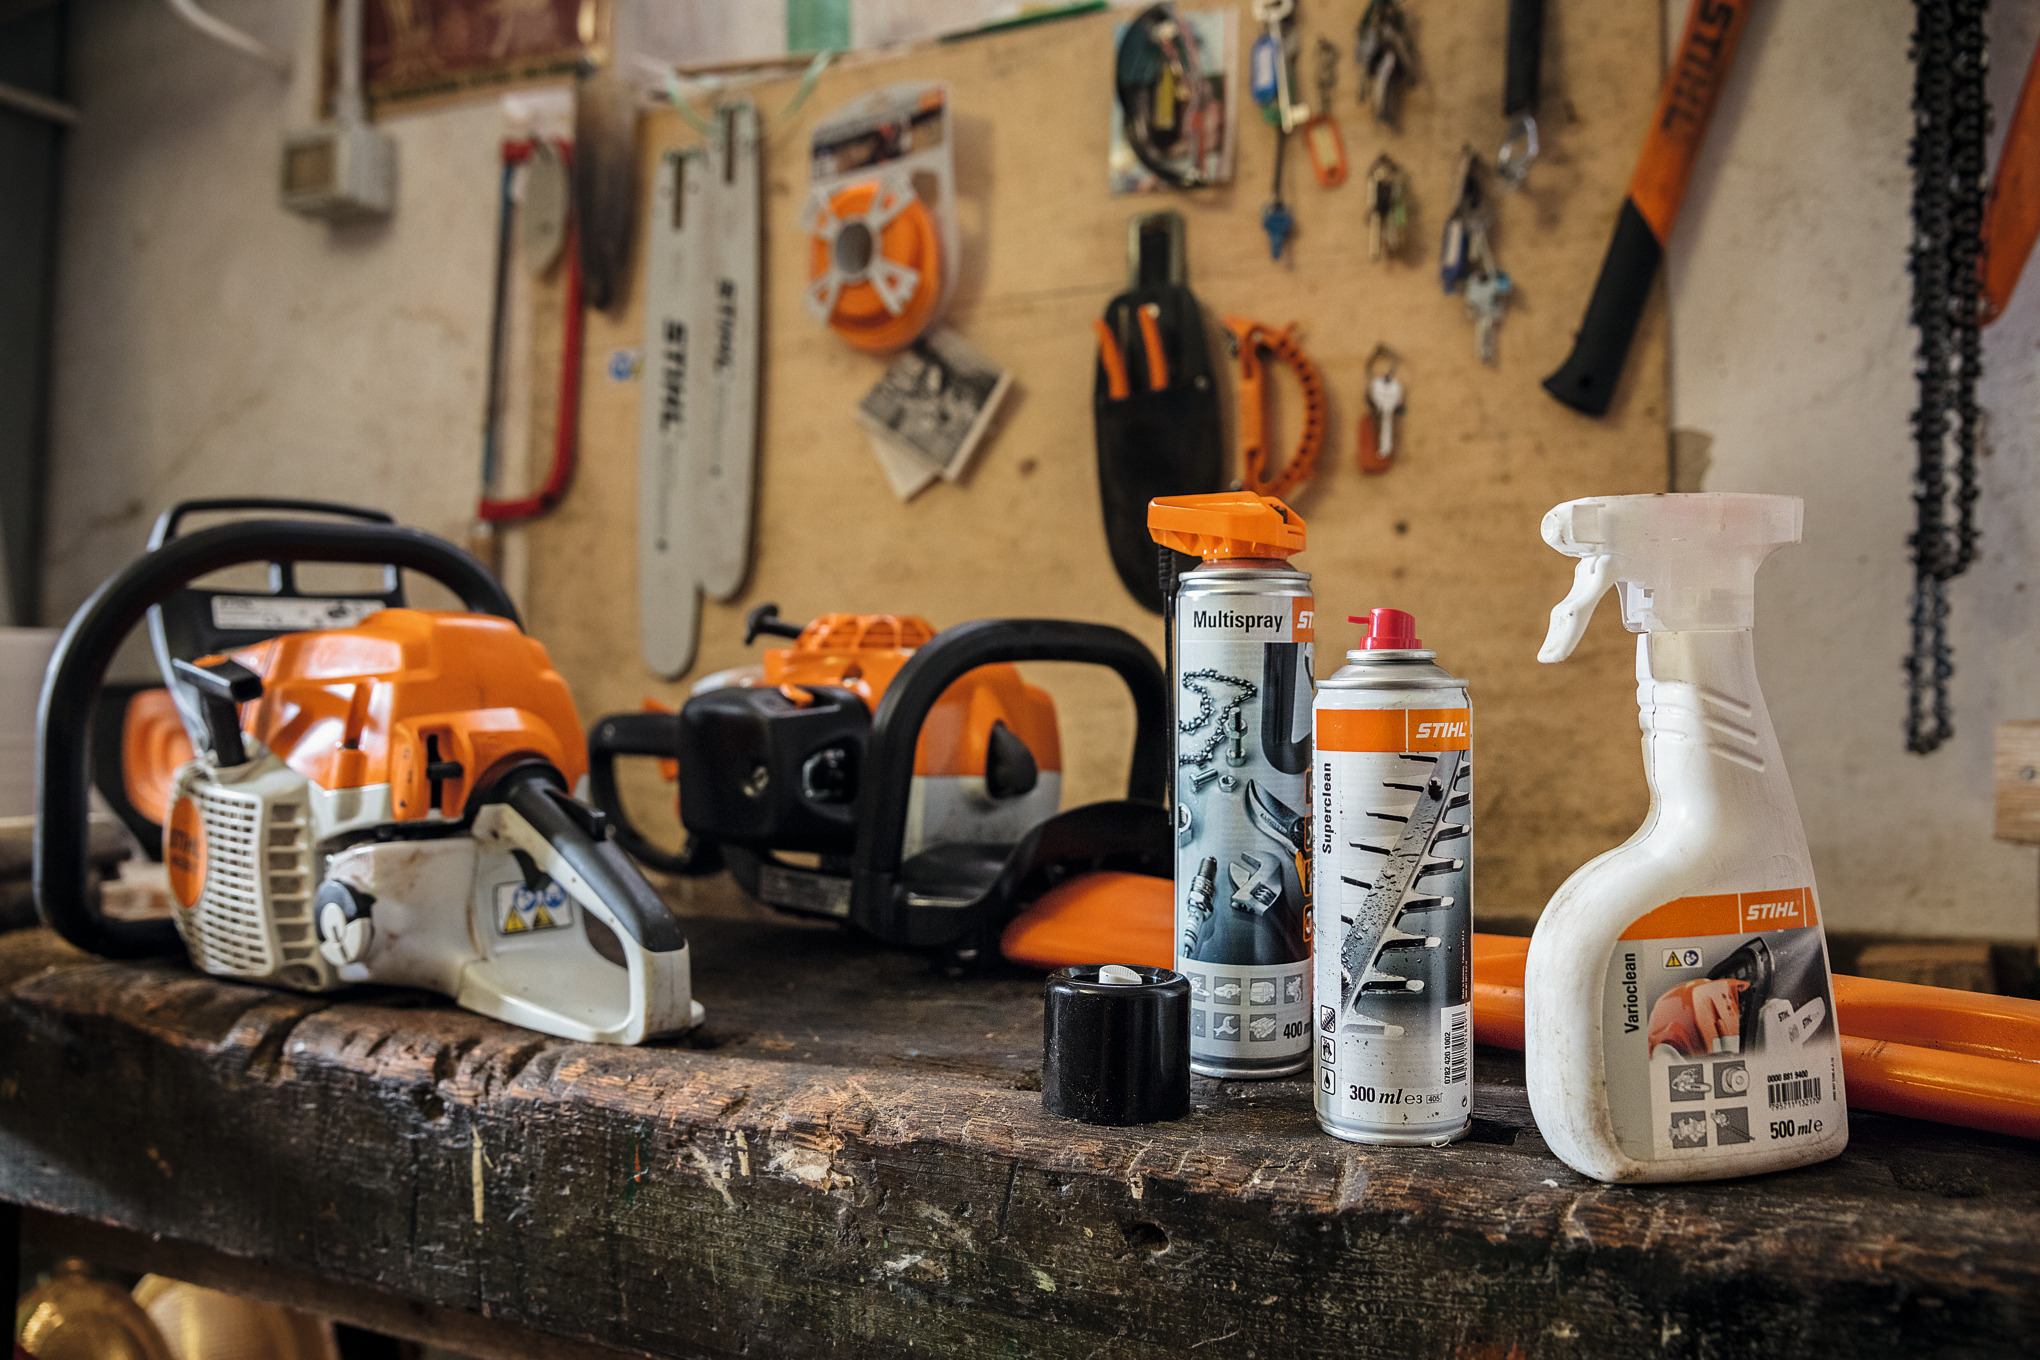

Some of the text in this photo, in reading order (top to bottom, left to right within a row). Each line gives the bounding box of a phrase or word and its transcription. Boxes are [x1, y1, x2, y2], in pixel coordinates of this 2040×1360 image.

[1661, 0, 1734, 130] STIHL
[661, 319, 688, 432] STIHL
[1193, 610, 1283, 633] Multispray
[1416, 721, 1467, 739] STIHL
[1322, 762, 1335, 855] Superclean
[1746, 901, 1799, 921] STIHL
[1622, 952, 1640, 1034] Varioclean
[1283, 1020, 1303, 1039] 400
[1767, 1073, 1782, 1083] 0000
[1349, 1084, 1376, 1103] 300
[1379, 1088, 1404, 1105] ml
[1770, 1119, 1795, 1140] 500
[1797, 1119, 1813, 1136] ml
